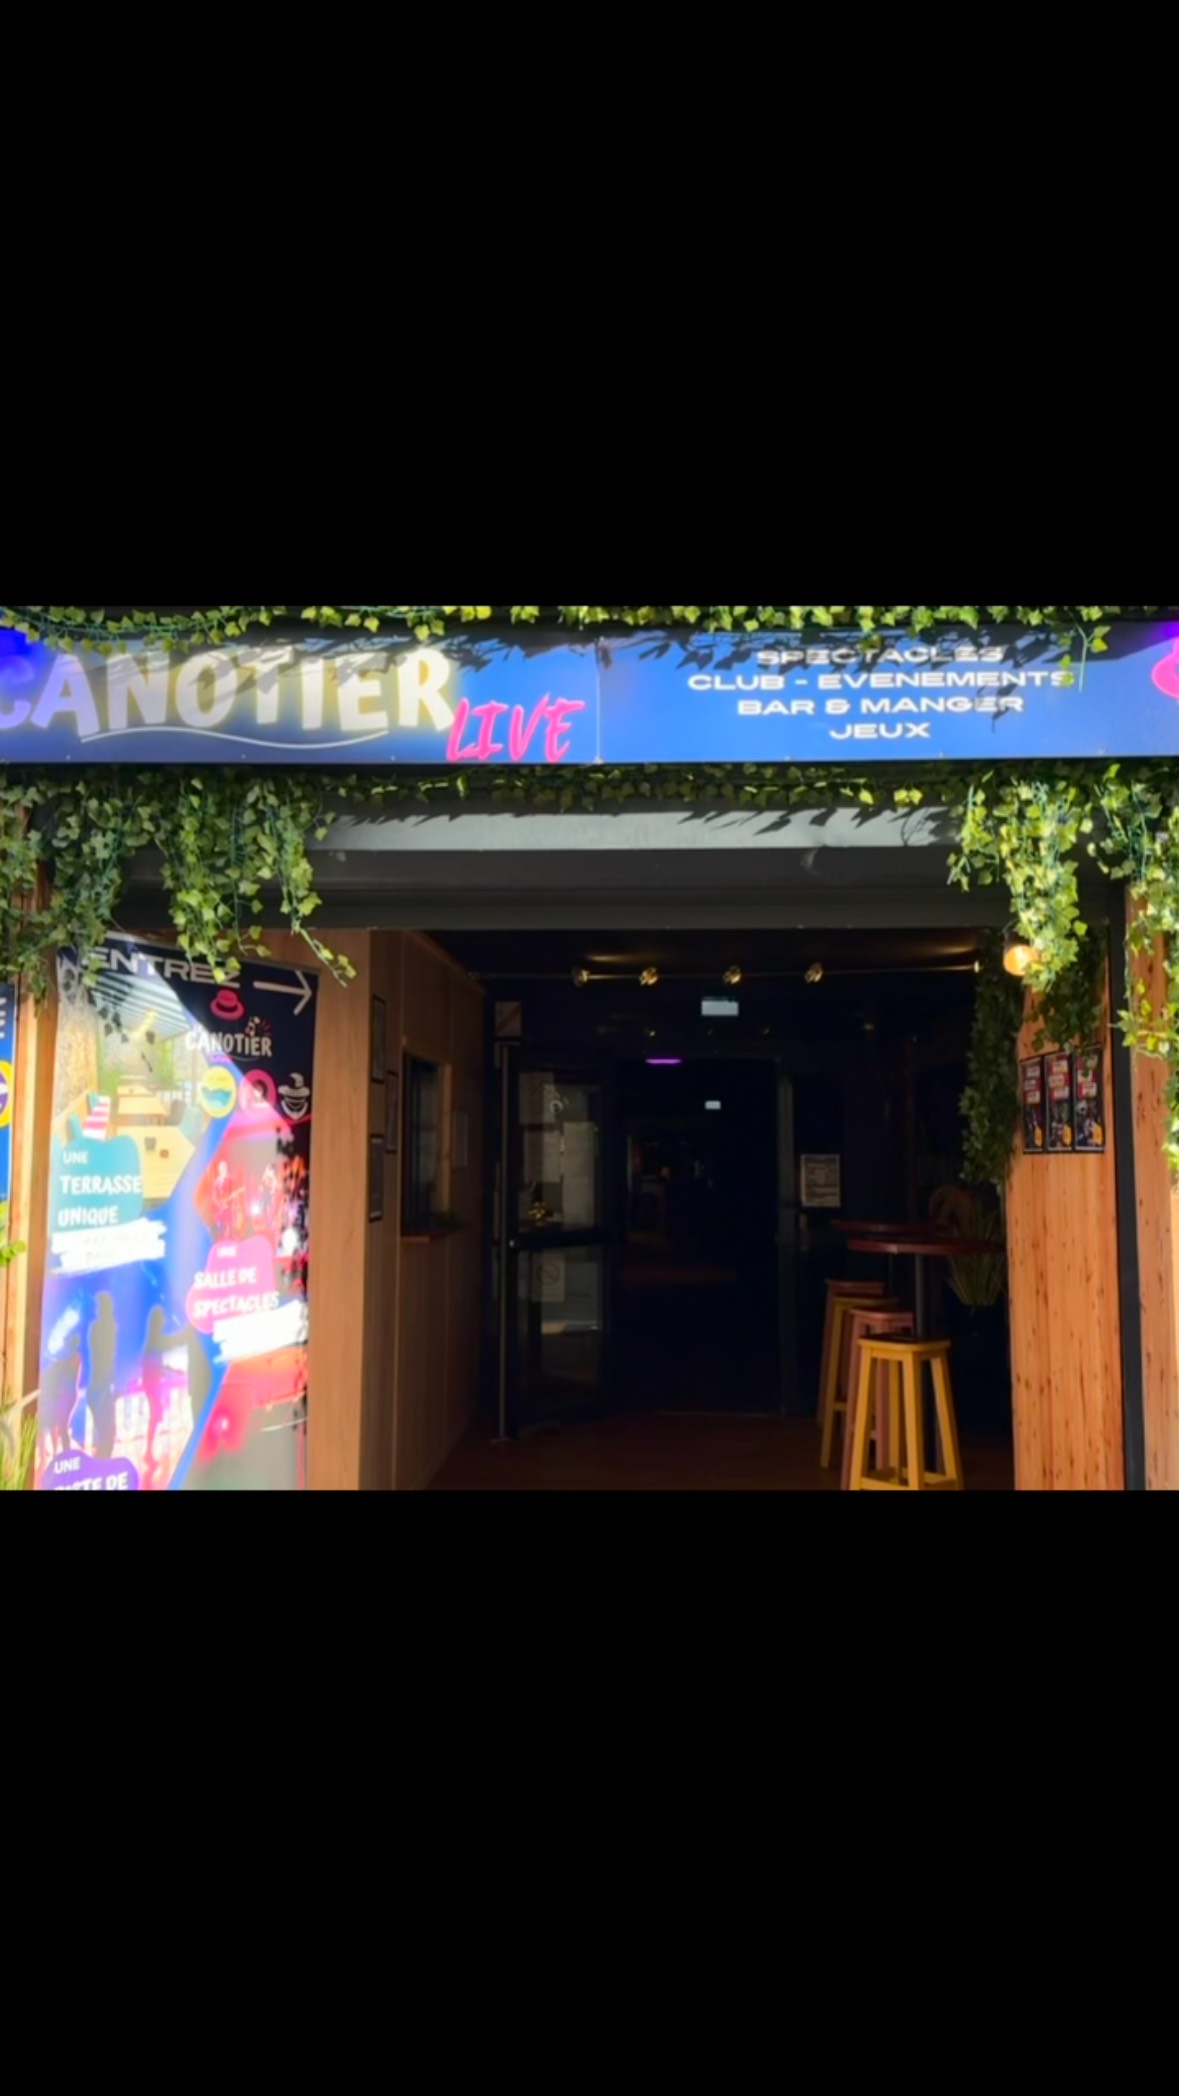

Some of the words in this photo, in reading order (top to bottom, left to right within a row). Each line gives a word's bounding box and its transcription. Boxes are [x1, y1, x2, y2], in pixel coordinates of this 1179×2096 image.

[757, 648, 1004, 665] SPECTACLES
[0, 647, 453, 736] CANOTIER
[688, 674, 784, 691] CLUB
[818, 672, 1074, 689] EVENEMENTS
[738, 699, 815, 715] BAR
[826, 699, 850, 714] &
[861, 696, 1024, 713] MANGER
[446, 696, 586, 762] LIVE
[829, 722, 931, 739] JEUX
[90, 946, 241, 988] ENTREZ
[185, 1031, 272, 1057] CANOTIER
[63, 1151, 88, 1164] UNE
[60, 1175, 142, 1195] TERRASSE
[58, 1206, 118, 1226] UNIQUE
[195, 1270, 236, 1289] SALLE
[239, 1267, 256, 1284] DE
[193, 1292, 279, 1318] SPECTACLES
[54, 1457, 80, 1474] UNE
[106, 1472, 128, 1491] DE
